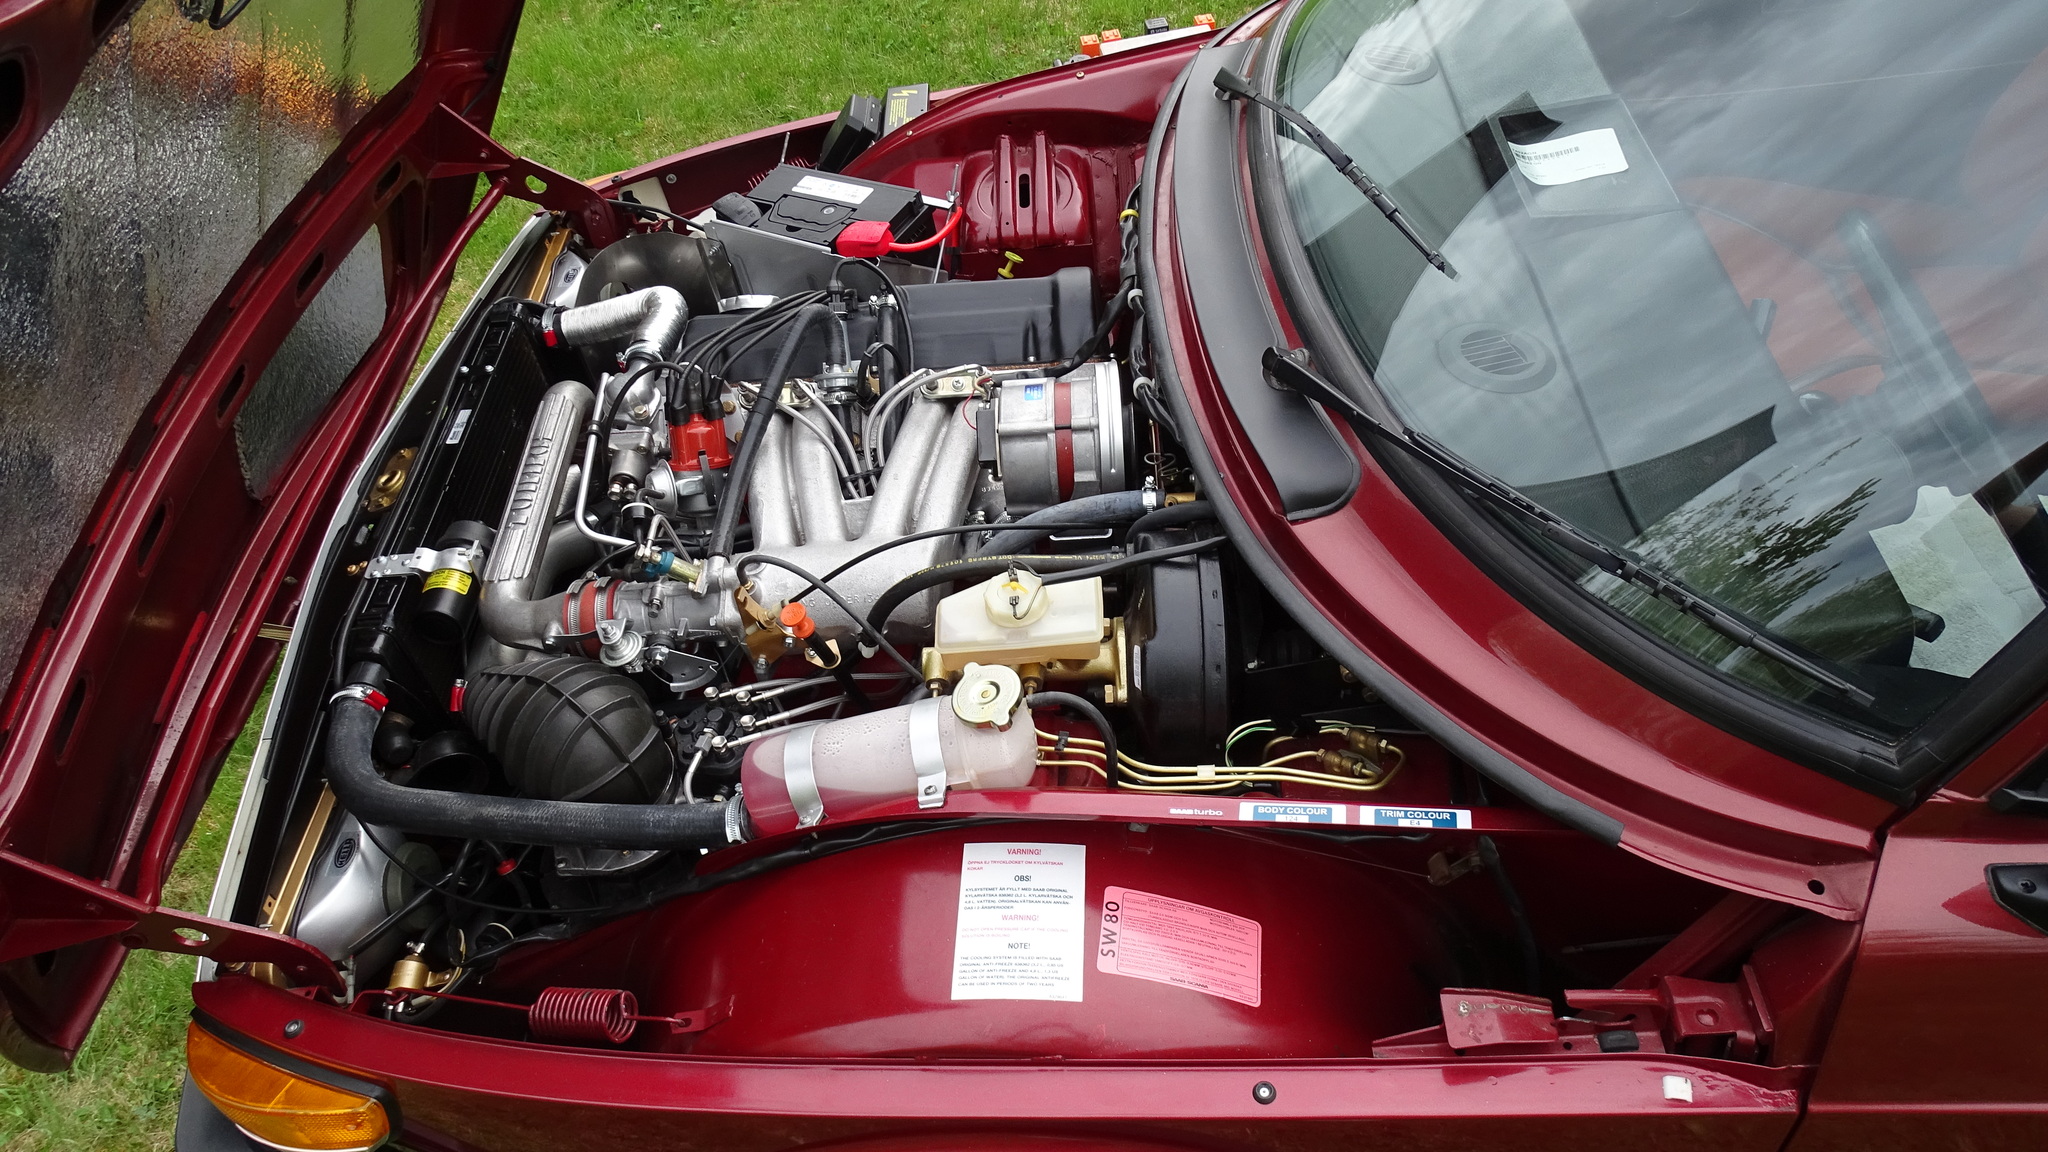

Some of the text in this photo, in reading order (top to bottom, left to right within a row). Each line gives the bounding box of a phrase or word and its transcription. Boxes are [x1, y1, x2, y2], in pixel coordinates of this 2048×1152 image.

[1194, 808, 1223, 816] turbo
[1286, 808, 1328, 816] COLOUR
[1380, 810, 1450, 820] TRIM COLOUR
[1100, 901, 1120, 958] SW 80
